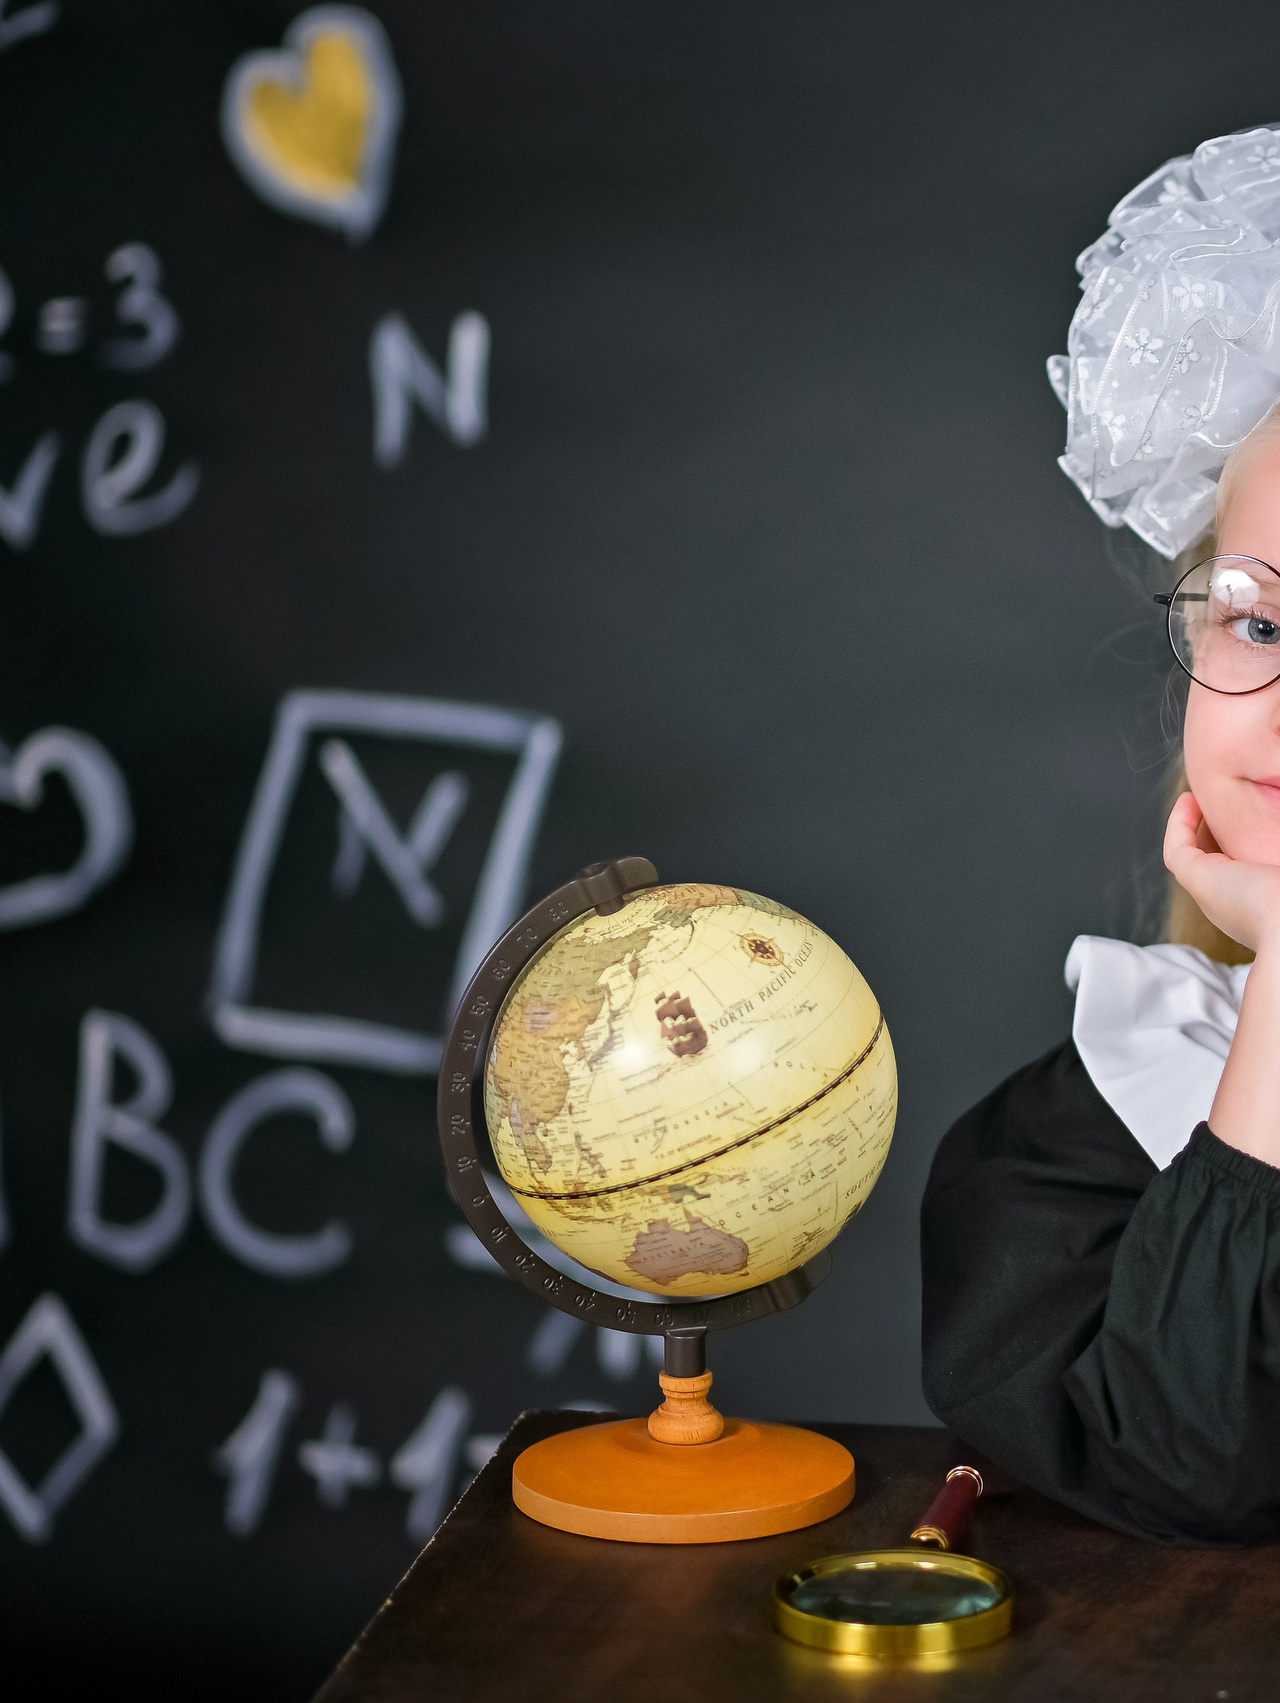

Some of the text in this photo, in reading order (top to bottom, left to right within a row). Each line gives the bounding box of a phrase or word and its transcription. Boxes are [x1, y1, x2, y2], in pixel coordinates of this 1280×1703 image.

[367, 310, 492, 470] N
[708, 1001, 755, 1034] NORTH
[757, 966, 797, 1002] PACIFIC
[794, 939, 814, 968] OCEAN
